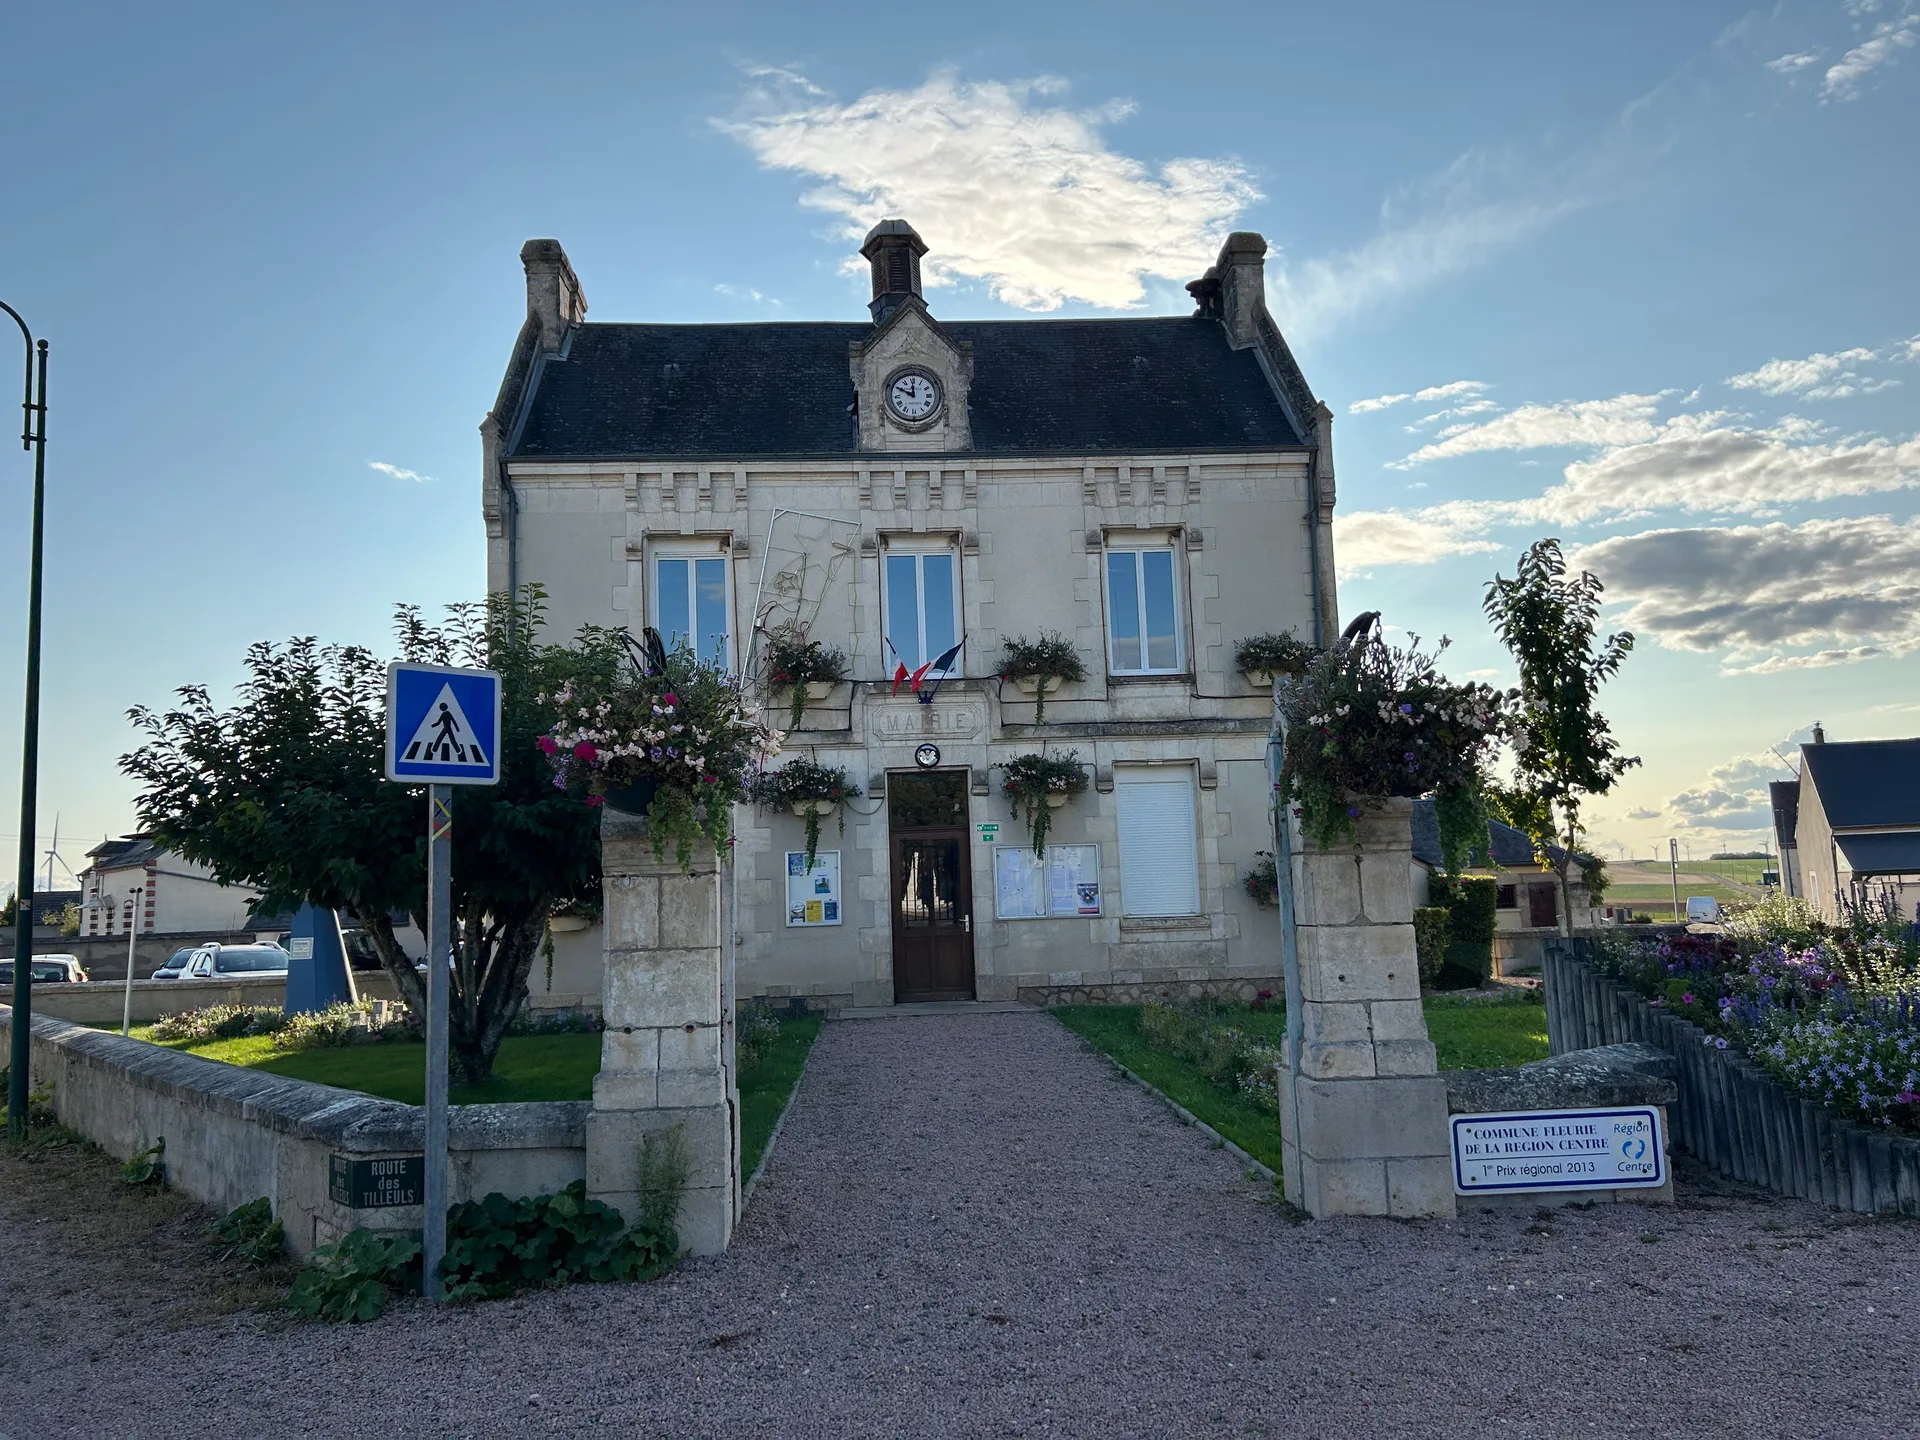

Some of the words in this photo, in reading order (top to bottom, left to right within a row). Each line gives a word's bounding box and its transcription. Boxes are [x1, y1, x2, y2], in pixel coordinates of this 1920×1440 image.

[886, 713, 966, 731] MAIRIE
[1474, 1127, 1539, 1140] COMMUNE
[1544, 1124, 1597, 1137] FLEURIE
[1614, 1123, 1649, 1135] Région
[1465, 1144, 1480, 1154] DE
[1485, 1143, 1500, 1154] LA
[1504, 1140, 1554, 1153] REGION
[1559, 1138, 1609, 1150] CENTRE
[371, 1160, 407, 1176] ROUTE
[1497, 1165, 1517, 1176] Prix
[1520, 1163, 1562, 1177] régional
[1567, 1162, 1595, 1173] 2013
[1618, 1162, 1652, 1172] Centre
[378, 1177, 400, 1190] des
[363, 1189, 414, 1206] TILLEULS
